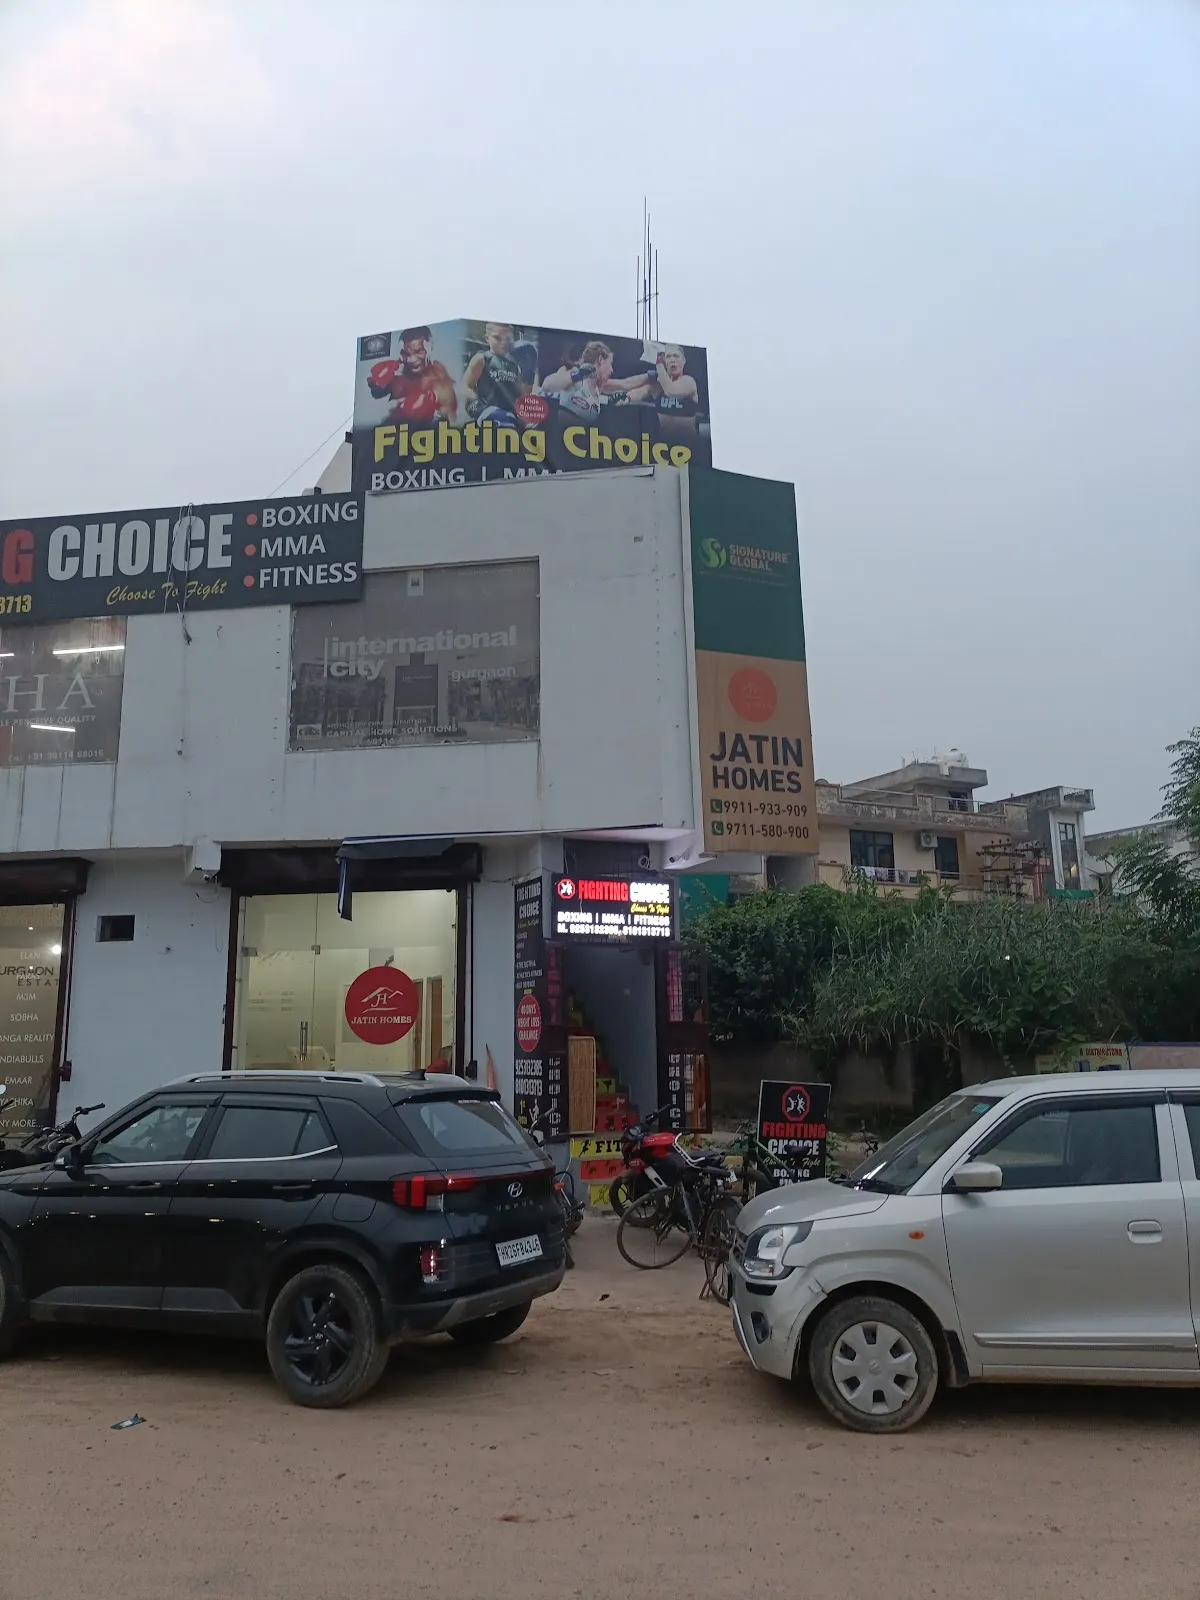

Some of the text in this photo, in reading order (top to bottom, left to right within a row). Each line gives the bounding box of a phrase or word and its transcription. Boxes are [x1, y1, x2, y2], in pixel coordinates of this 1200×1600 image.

[373, 420, 692, 466] Fighting Choice
[371, 467, 465, 491] BOXING
[262, 500, 359, 528] BOXING
[2, 513, 234, 585] G CHOICE
[260, 534, 327, 559] MMA
[729, 544, 789, 564] SIGNATURE
[729, 554, 773, 572] GLOBAL
[259, 562, 358, 589] FITNESS
[106, 579, 229, 606] Choose To Fight
[331, 625, 517, 658] international
[329, 658, 386, 681] city
[451, 665, 516, 682] gurgaon
[57, 714, 96, 724] QUALITY
[401, 725, 458, 735] SOLUTIONS
[709, 731, 804, 768] JATIN
[712, 765, 802, 794] HOMES
[723, 800, 808, 818] 9911-933-909
[726, 822, 810, 839] 9711-580-900
[516, 882, 541, 902] FIGHTING
[578, 879, 629, 902] FIGHTING
[519, 901, 540, 919] CHOICE
[16, 992, 37, 1001] M3M
[10, 1013, 39, 1022] SOBHA
[351, 1015, 412, 1025] JATIN HOMES
[24, 1034, 55, 1043] REALITY
[0, 1055, 44, 1064] NDIABULLS
[4, 1076, 33, 1085] EMAAR
[762, 1121, 827, 1139] FIGHTING
